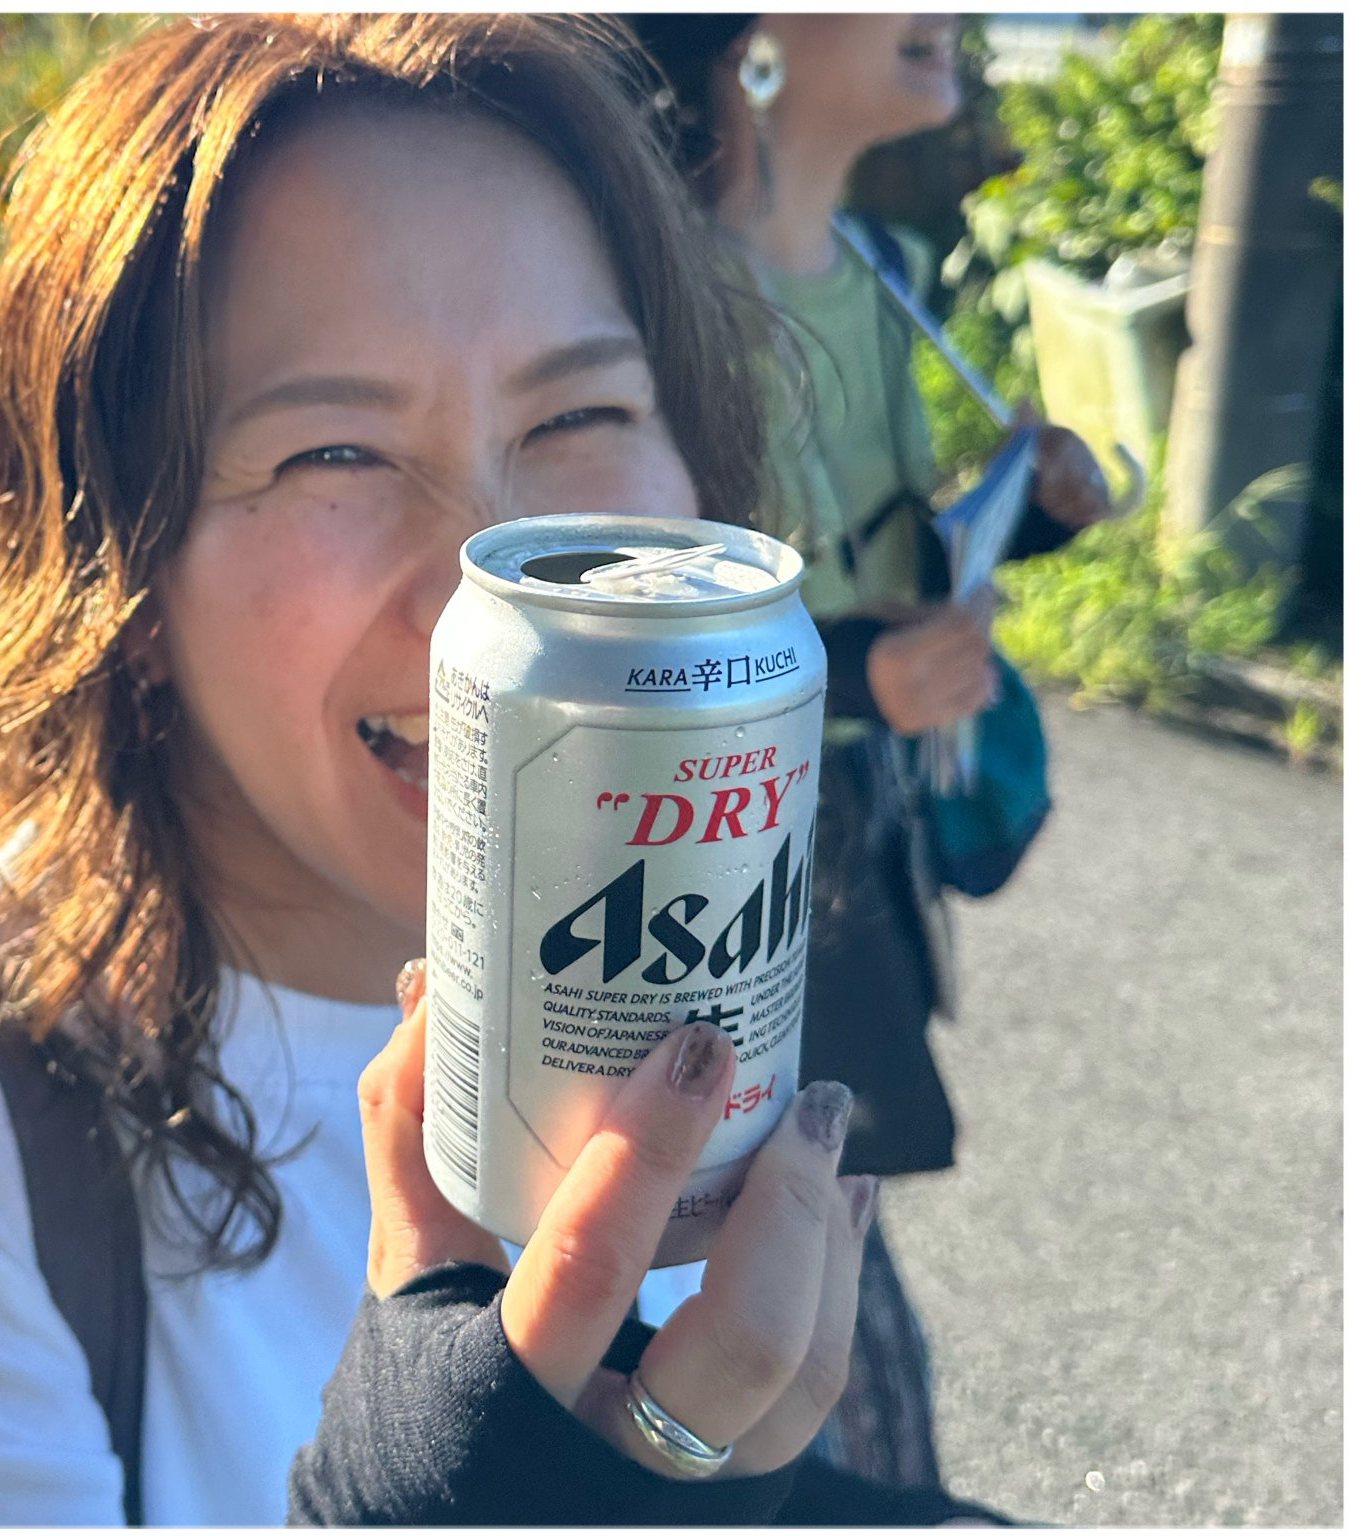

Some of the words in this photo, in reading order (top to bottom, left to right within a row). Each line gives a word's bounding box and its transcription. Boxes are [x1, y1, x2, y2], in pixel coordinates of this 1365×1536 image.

[627, 668, 689, 686] KARA
[692, 655, 751, 692] 辛口
[755, 647, 797, 676] KUCHI
[674, 746, 777, 782] SUPER
[544, 983, 583, 999] ASAHI
[586, 990, 627, 1004] SUPER
[630, 993, 658, 1004] DRY
[659, 993, 672, 1004] IS
[673, 987, 723, 1003] BREWED
[725, 978, 753, 996] WITH
[543, 1001, 596, 1019] QUALITY
[543, 1018, 586, 1037] VISION
[587, 1027, 606, 1039] OF
[542, 1037, 567, 1051] OUR
[567, 1043, 633, 1059] ADVANCED
[541, 1054, 595, 1074] DELIVER
[595, 1065, 605, 1076] A
